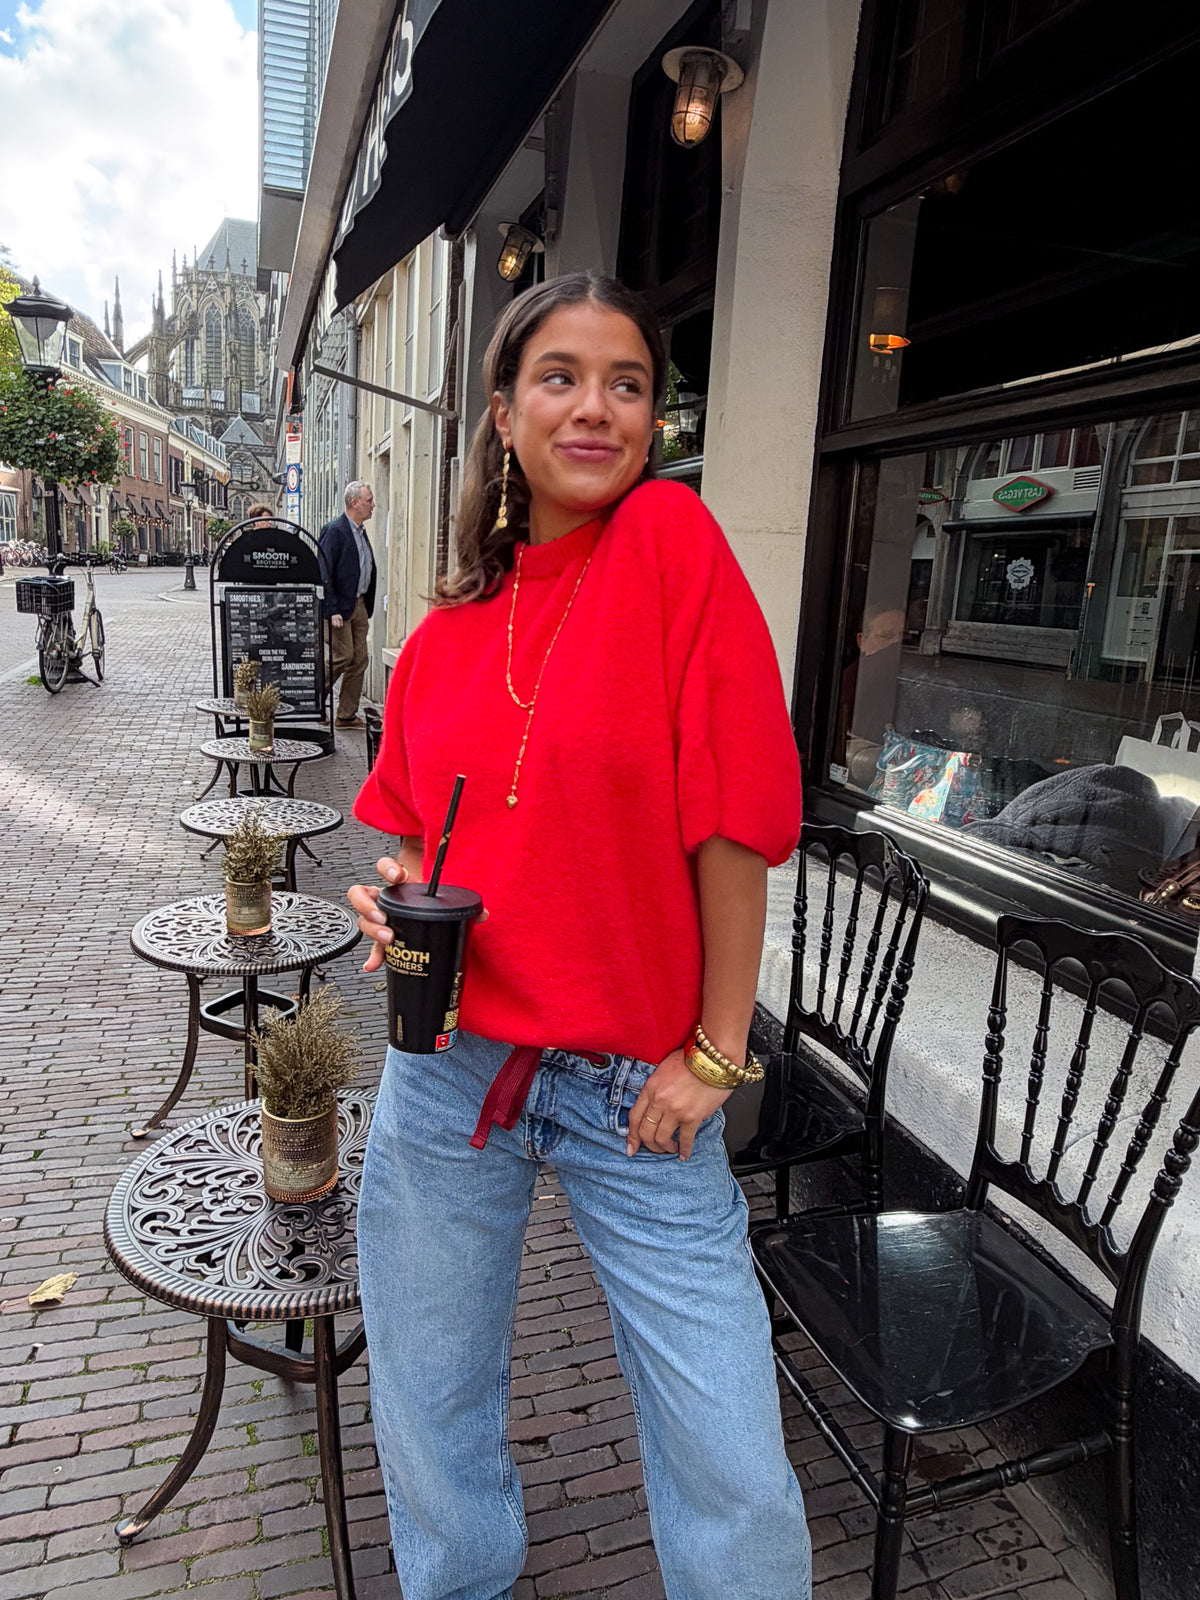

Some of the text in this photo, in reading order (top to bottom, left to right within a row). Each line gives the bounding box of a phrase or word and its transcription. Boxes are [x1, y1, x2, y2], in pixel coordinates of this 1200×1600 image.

[252, 551, 290, 561] SMOOTH
[229, 594, 261, 603] SMOOTHIES
[296, 595, 314, 603] JUICES
[281, 662, 315, 671] SANDWICHES
[384, 943, 430, 964] MOOTH
